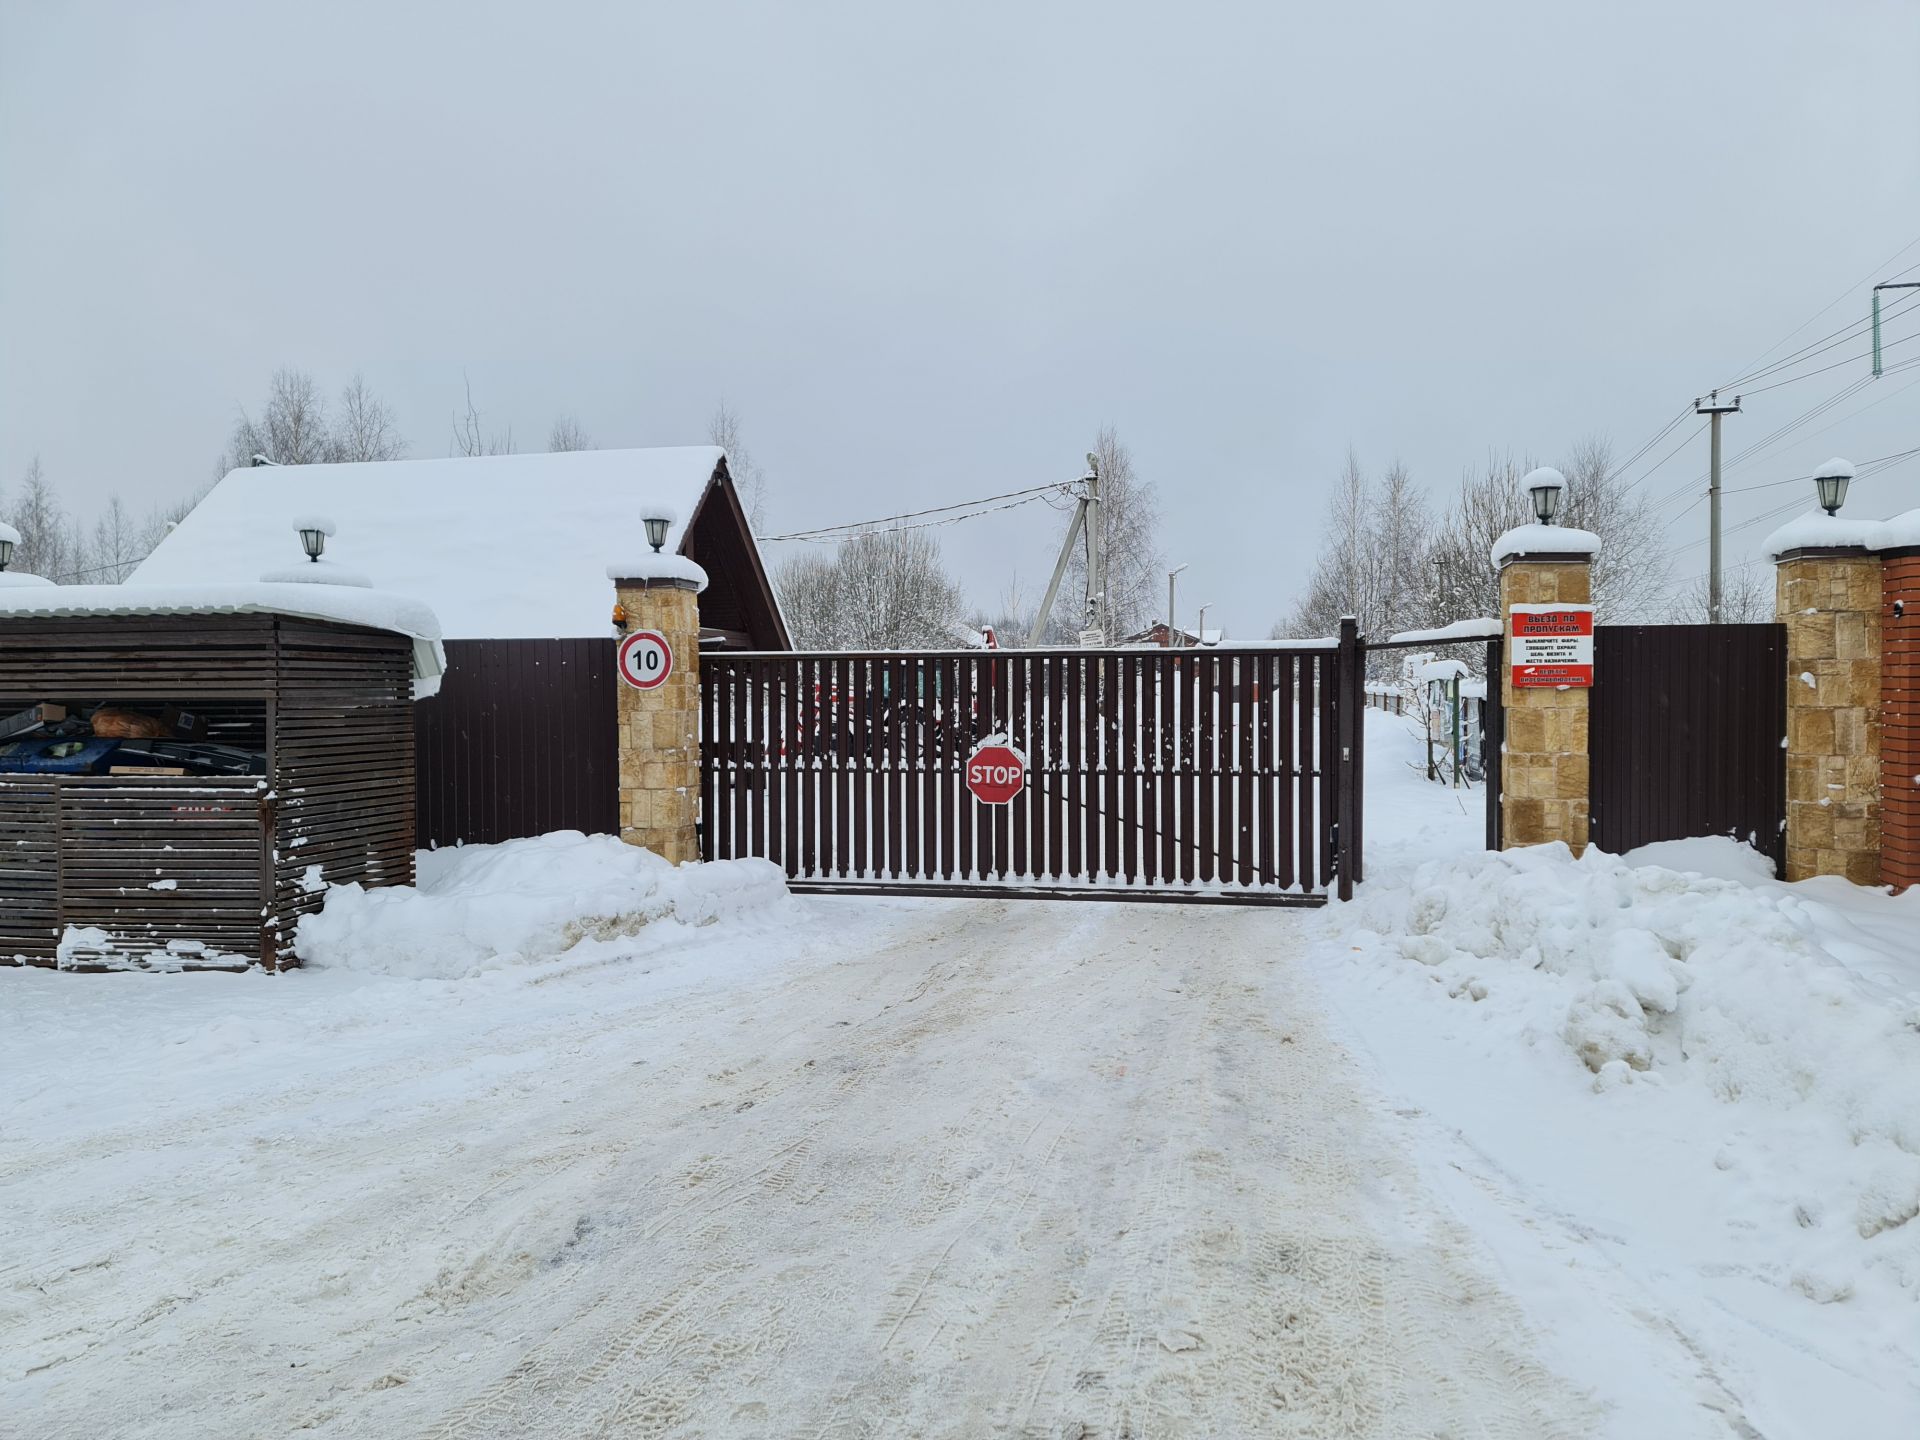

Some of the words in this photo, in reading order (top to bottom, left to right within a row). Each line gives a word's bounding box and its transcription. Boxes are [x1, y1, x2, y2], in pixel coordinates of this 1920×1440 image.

[1523, 625, 1580, 633] ПРОПУСКАМ
[633, 650, 658, 670] 10
[970, 765, 1020, 784] STOP
